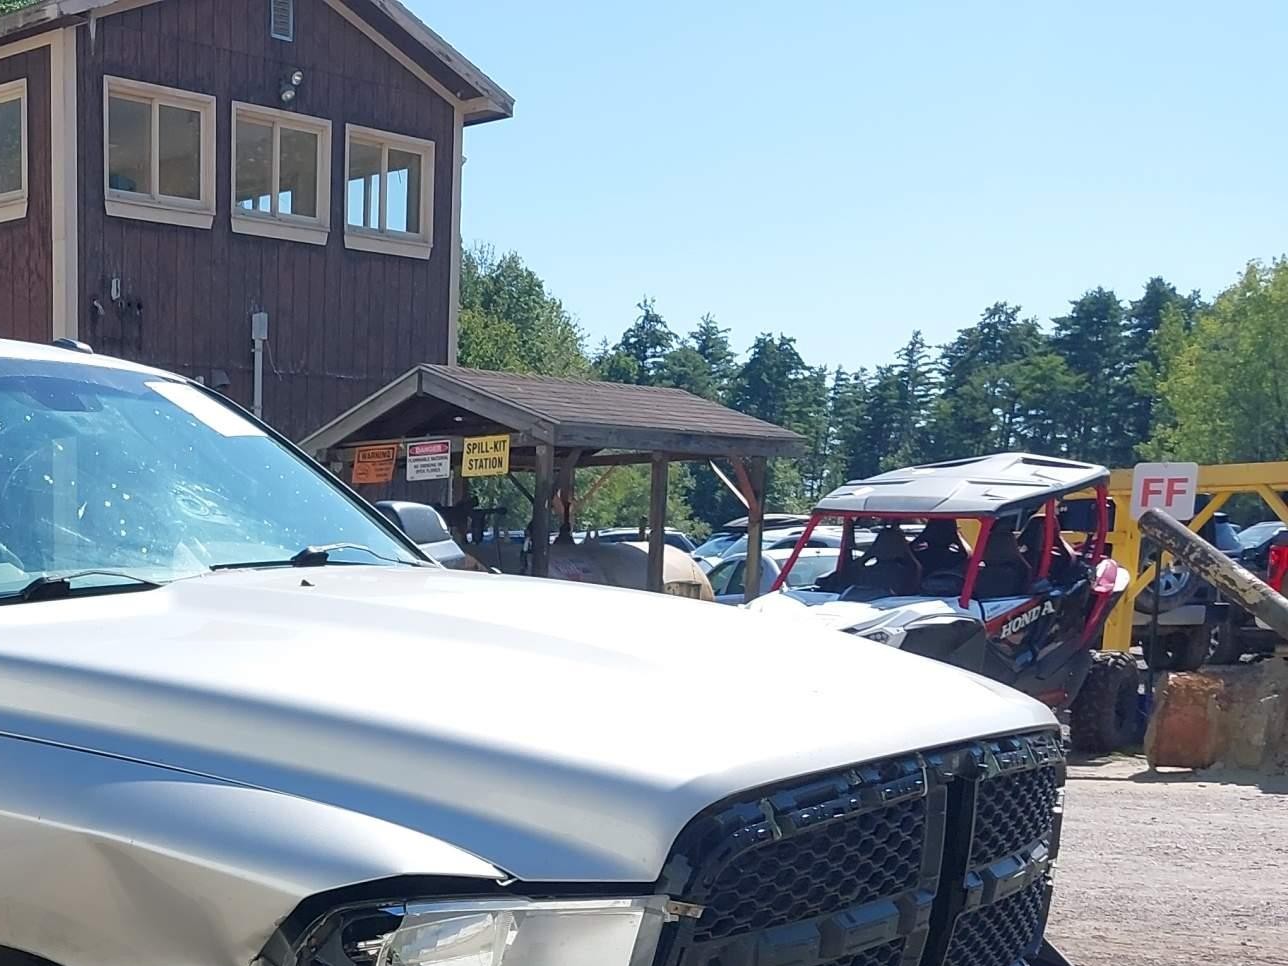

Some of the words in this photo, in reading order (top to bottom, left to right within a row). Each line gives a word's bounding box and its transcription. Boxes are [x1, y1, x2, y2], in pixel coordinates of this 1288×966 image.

[415, 444, 442, 454] DANGER
[466, 440, 507, 454] SPILL-KIT
[361, 450, 392, 460] WARNING
[468, 457, 503, 470] STATION
[1141, 478, 1189, 507] FF
[999, 600, 1056, 640] HONDA
